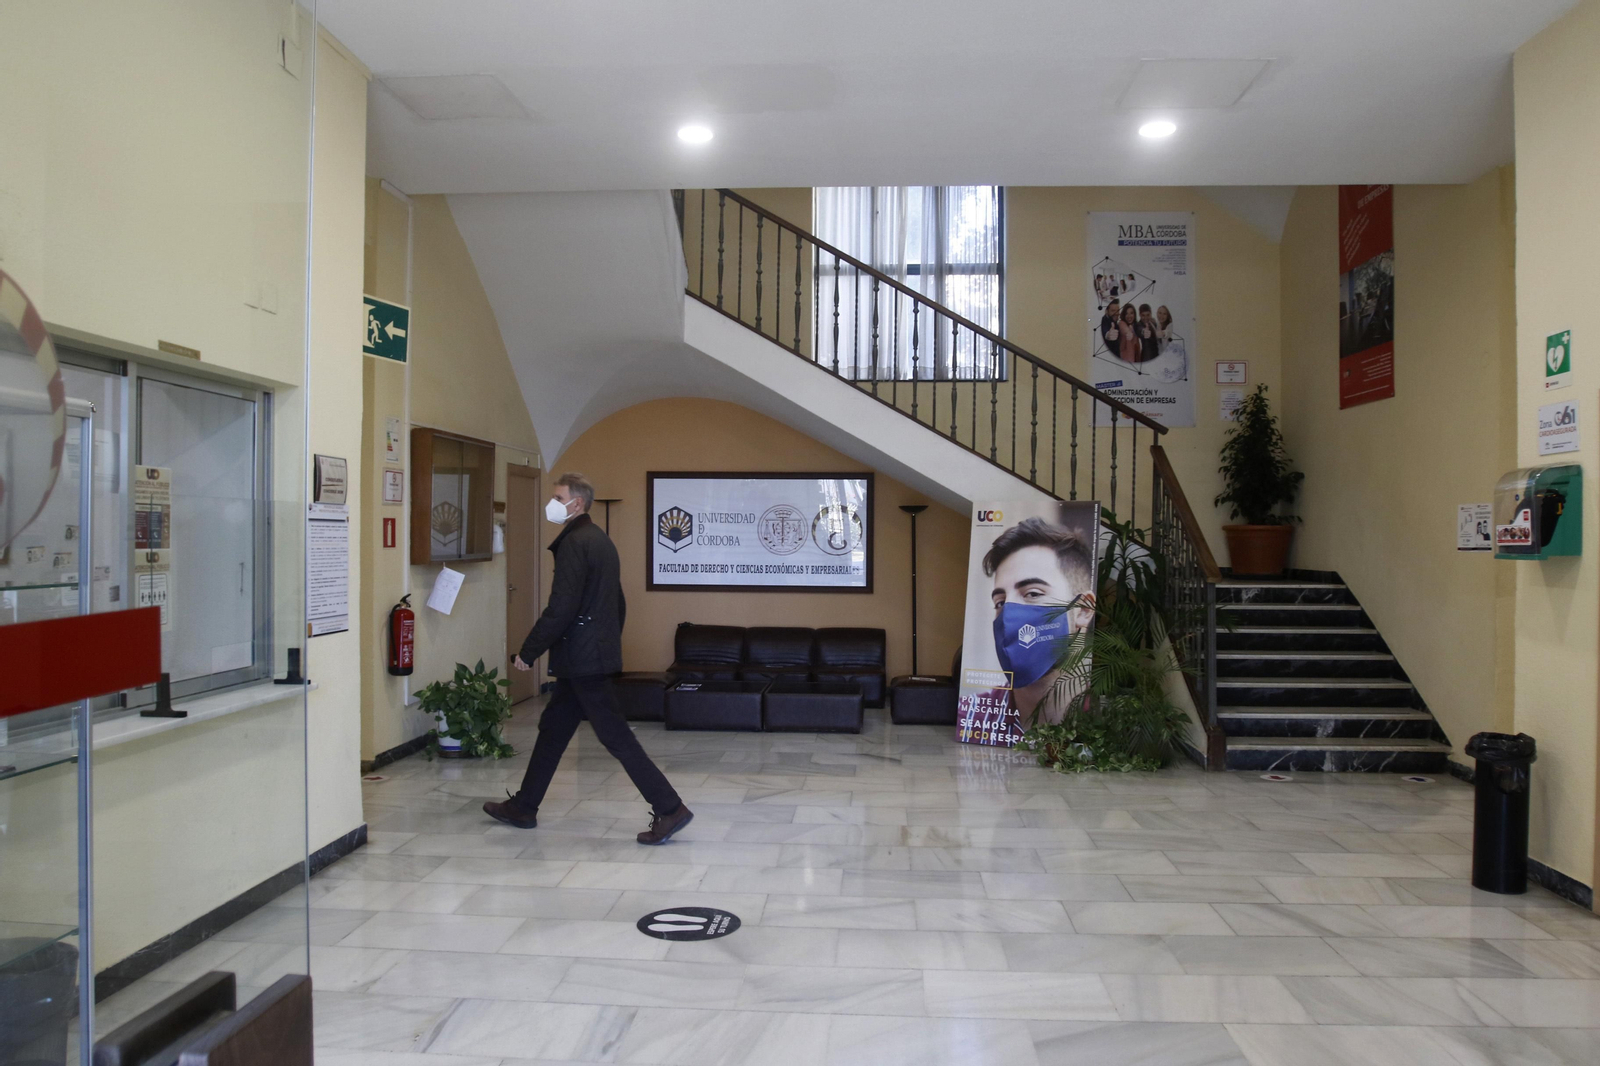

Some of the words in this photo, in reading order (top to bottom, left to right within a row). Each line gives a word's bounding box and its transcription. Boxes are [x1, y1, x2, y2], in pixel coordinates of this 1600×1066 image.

[1118, 225, 1156, 238] MBA
[1103, 388, 1153, 396] ADMINISTRACIÓN
[1539, 420, 1553, 430] Zona
[1554, 405, 1576, 427] 061
[697, 512, 756, 524] UNIVERSIDAD
[977, 510, 1004, 523] UCO
[696, 532, 741, 546] CÓRDOBA
[659, 563, 689, 573] FACULTAD
[690, 563, 699, 573] DE
[700, 563, 729, 573] DERECHO
[730, 564, 735, 574] Y
[735, 564, 764, 574] CIENCIAS
[764, 562, 804, 575] ECONÓMICAS
[805, 565, 810, 575] Y
[961, 695, 992, 705] PONTE
[995, 698, 1007, 706] LA
[961, 704, 1020, 717] MASCARILLA
[960, 718, 1007, 731] SEAMOS
